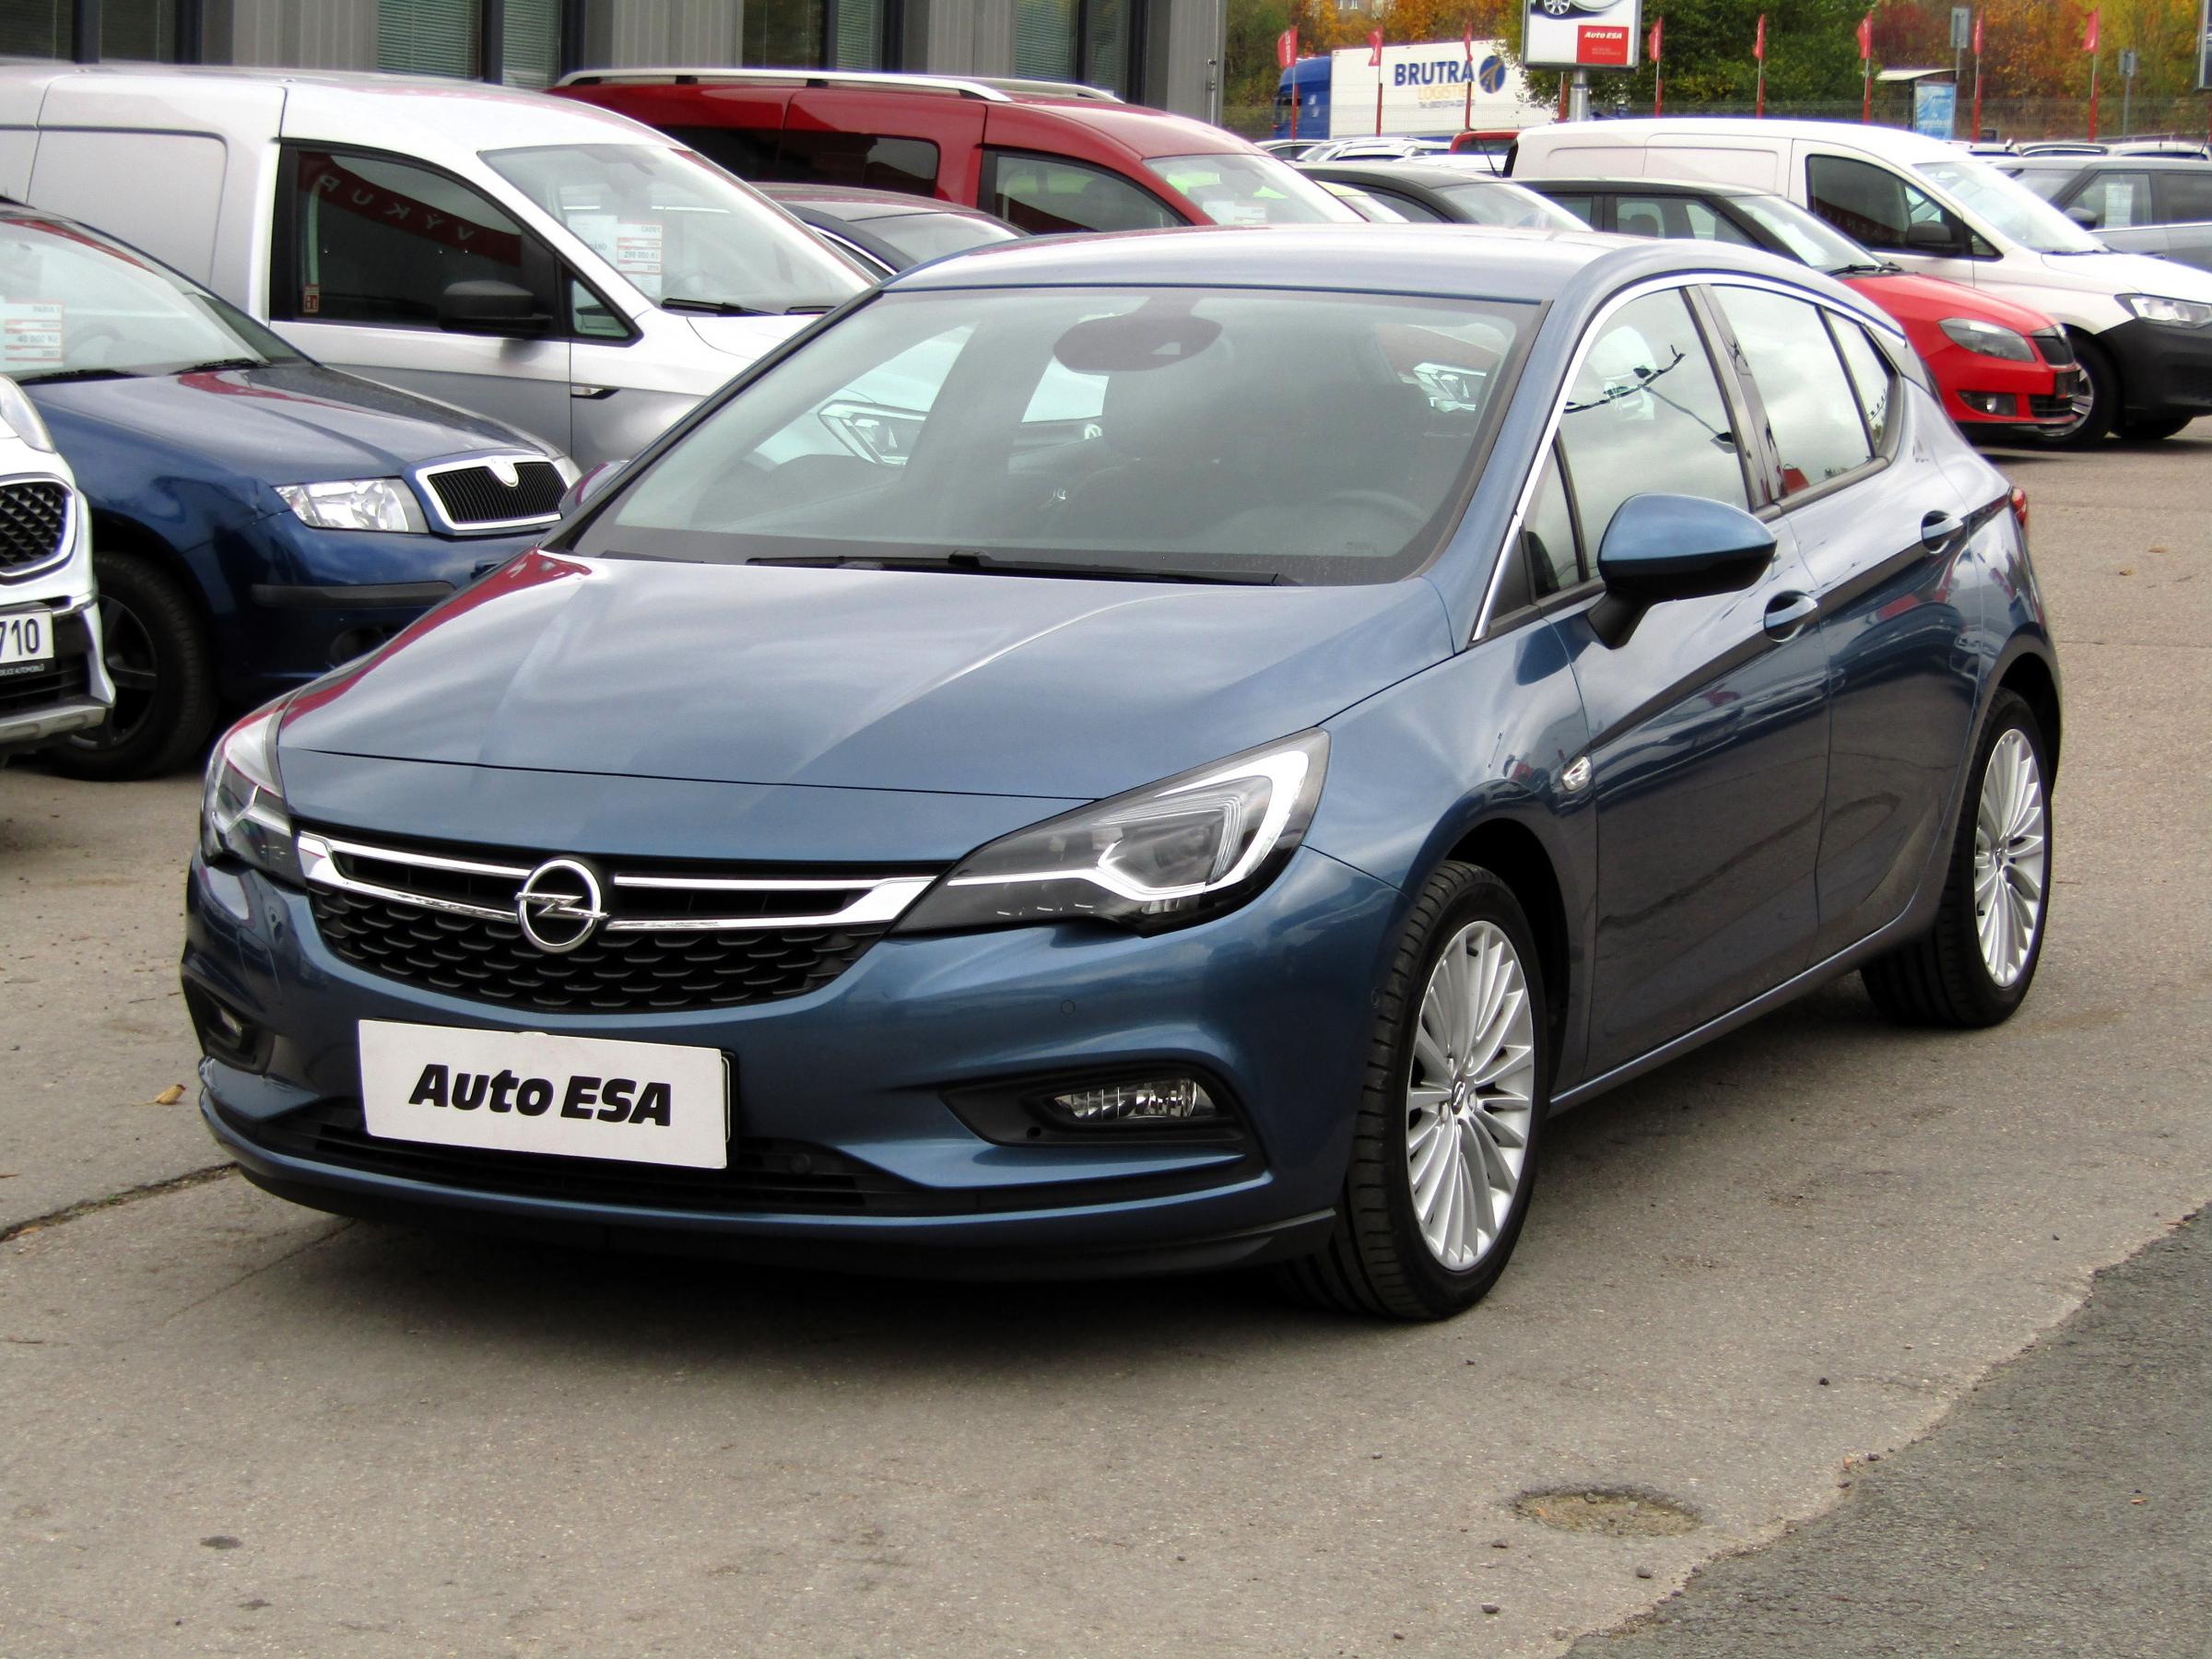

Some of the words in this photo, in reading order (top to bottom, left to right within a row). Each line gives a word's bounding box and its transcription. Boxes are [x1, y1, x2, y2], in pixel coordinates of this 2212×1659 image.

[1584, 31, 1606, 40] Auto
[1394, 60, 1476, 87] BRUTRA
[408, 1064, 554, 1116] Auto
[560, 1076, 671, 1126] ESA
